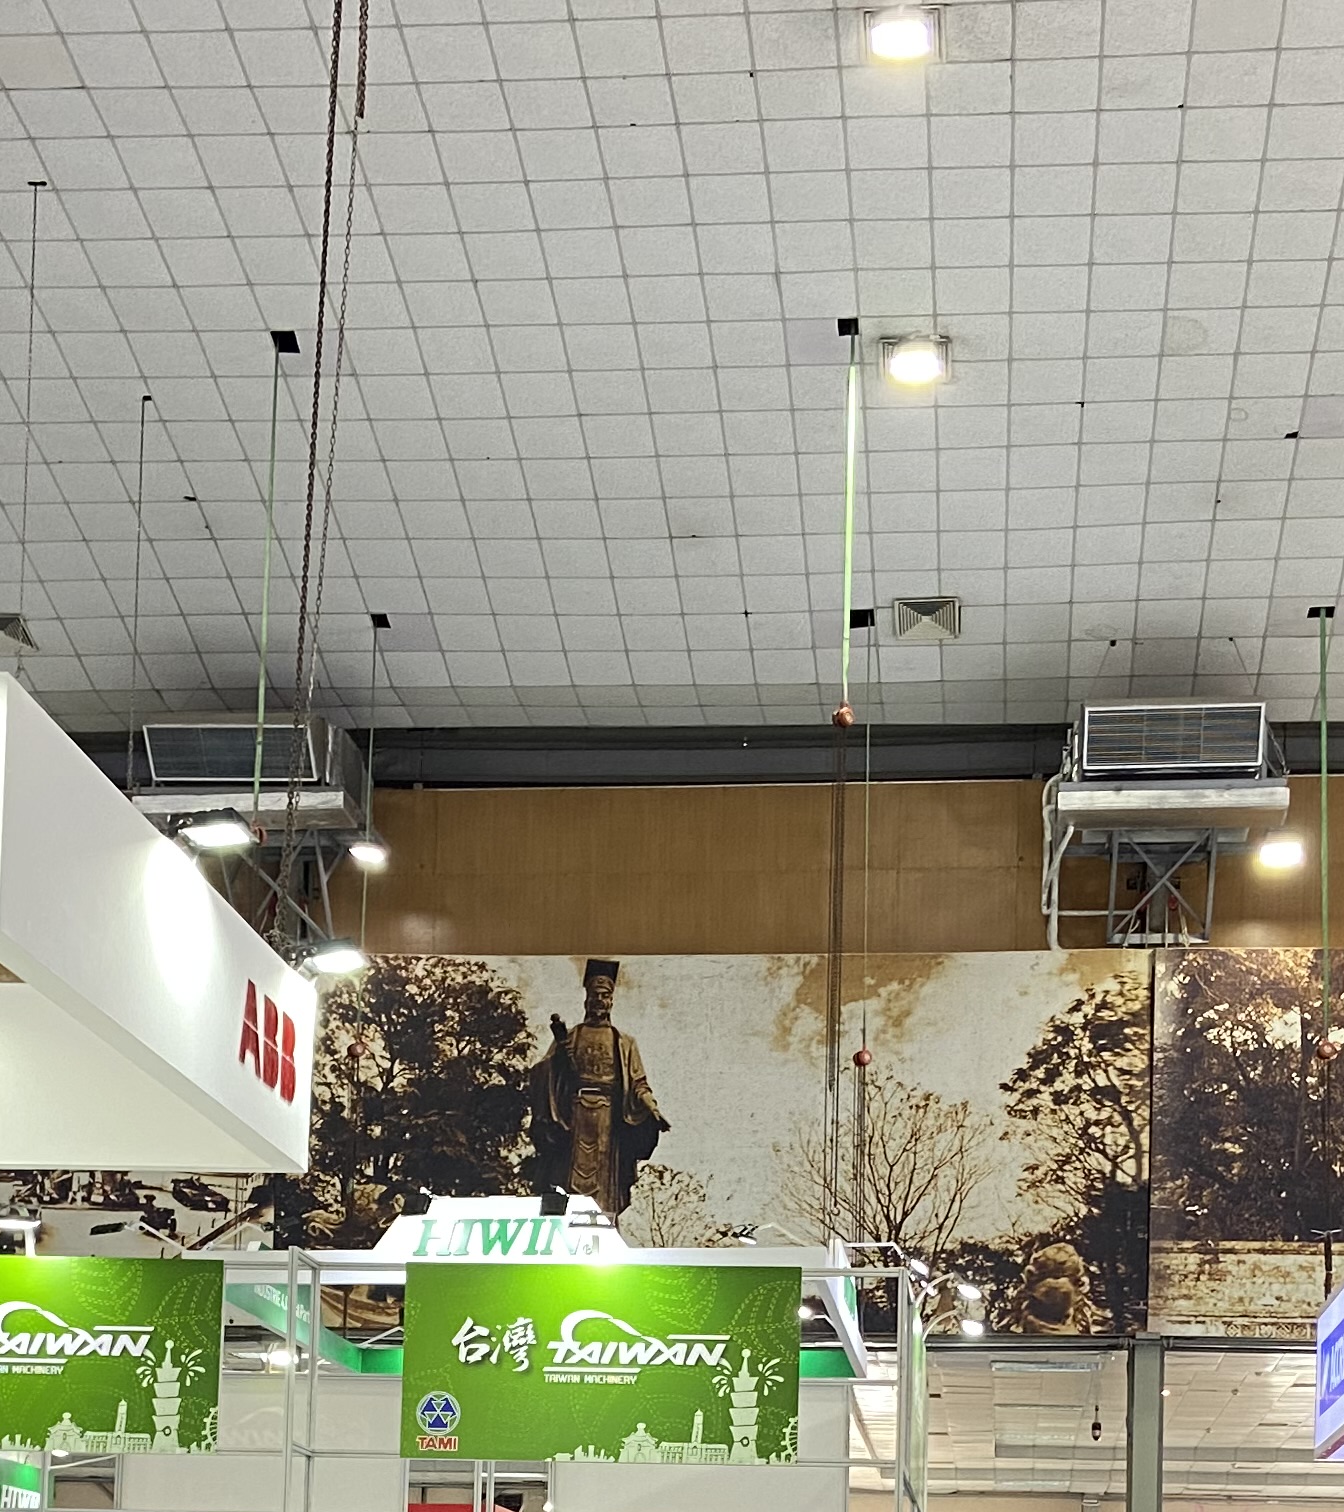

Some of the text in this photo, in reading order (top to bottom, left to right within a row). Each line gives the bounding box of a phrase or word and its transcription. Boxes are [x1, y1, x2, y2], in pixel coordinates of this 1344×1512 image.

[239, 978, 297, 1105] ABB
[451, 1316, 537, 1372] 台灣
[547, 1326, 728, 1366] TAIWAN
[12, 1365, 64, 1375] MACHINERY
[543, 1374, 638, 1385] TAIWAN MACHINERY
[416, 1435, 459, 1452] TAMI
